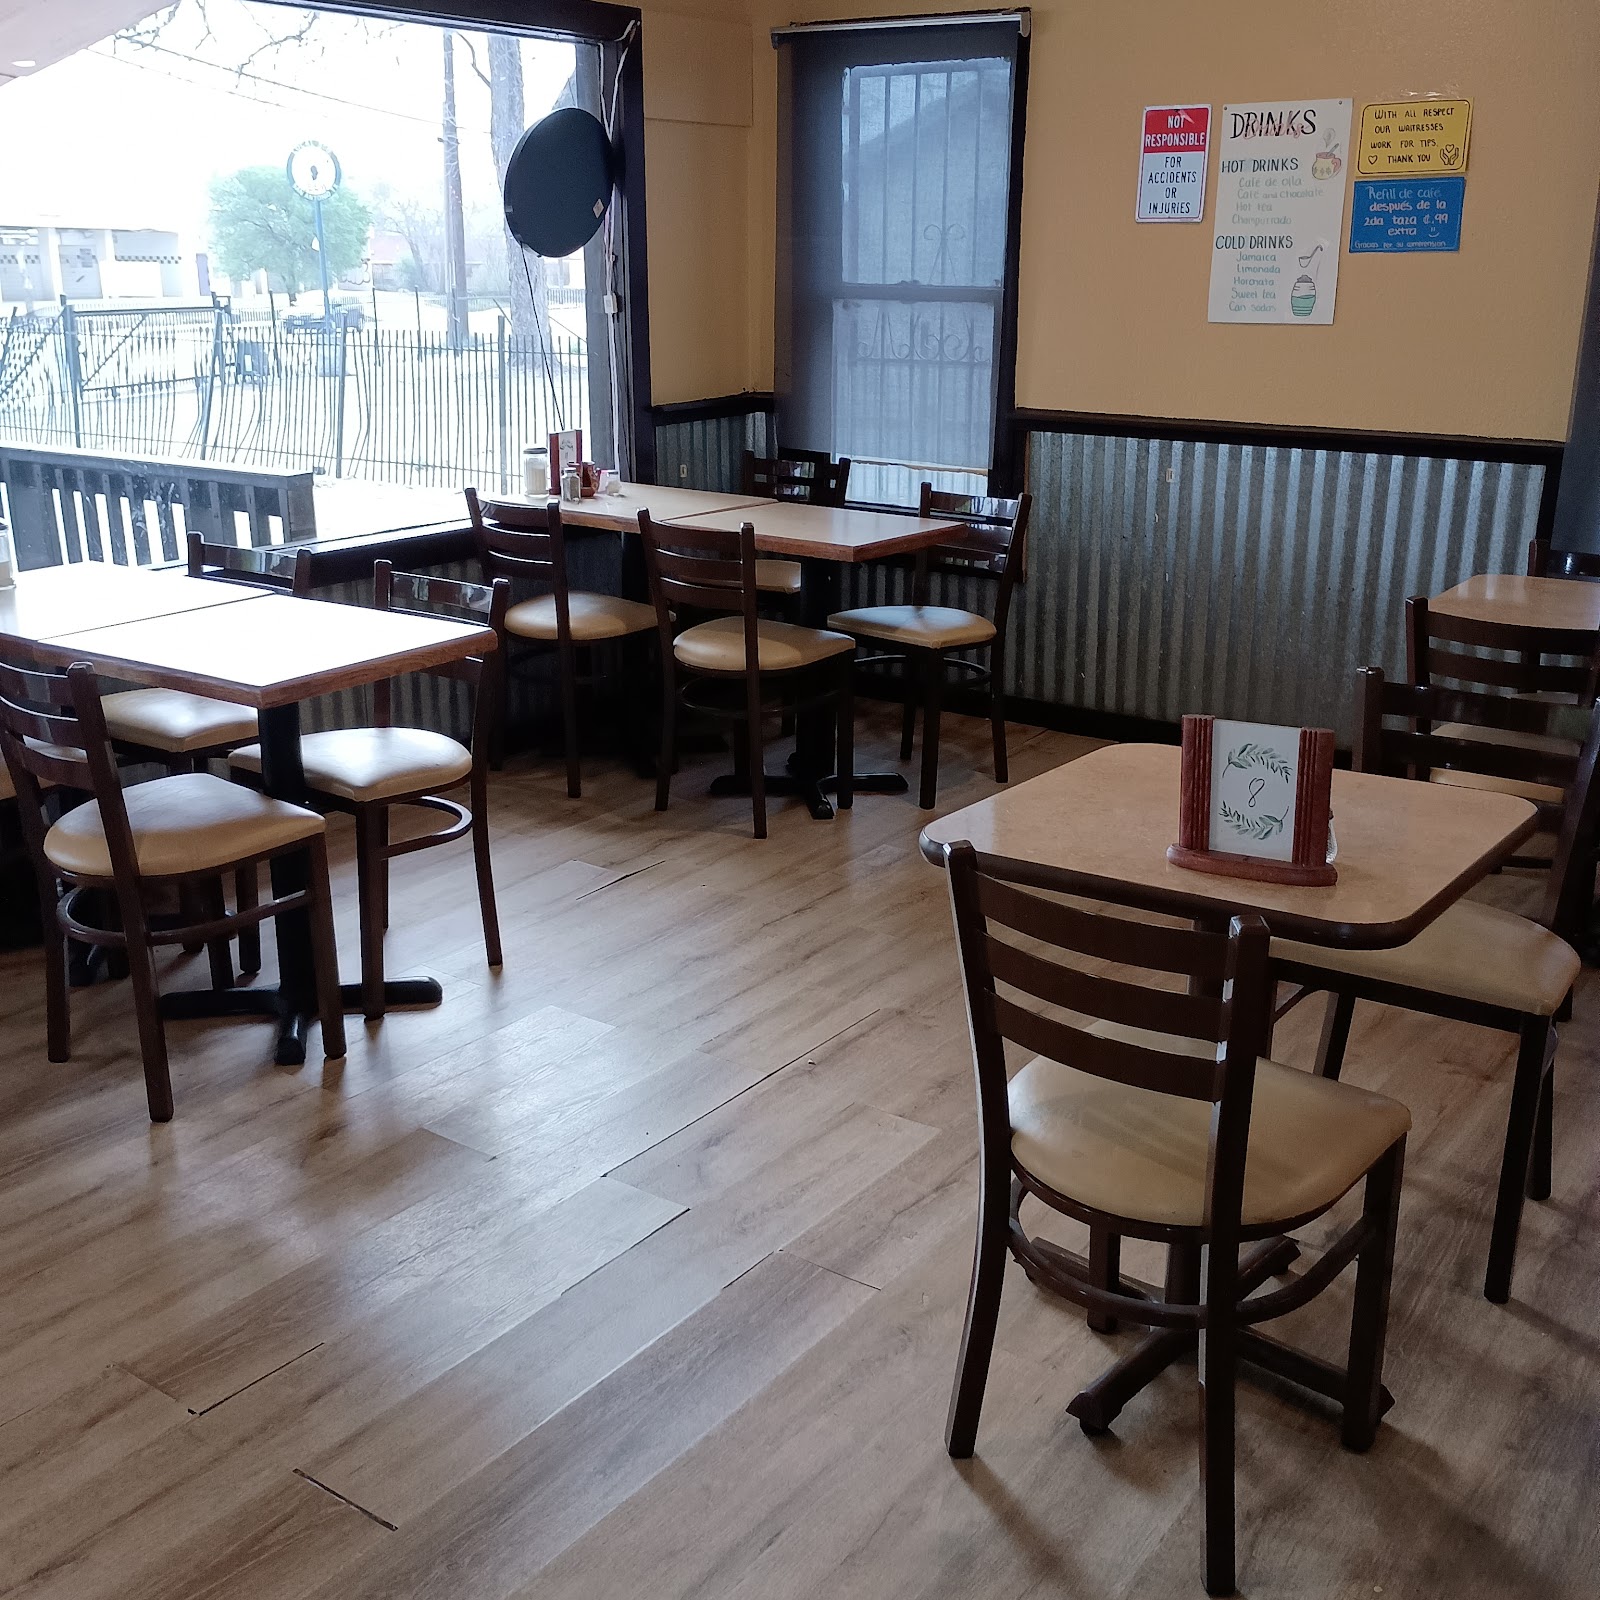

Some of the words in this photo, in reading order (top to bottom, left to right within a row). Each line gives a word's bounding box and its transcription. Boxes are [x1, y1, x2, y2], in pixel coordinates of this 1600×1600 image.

[1374, 109, 1397, 119] WITH
[1404, 109, 1416, 117] ALL
[1423, 107, 1455, 118] RESPECT
[1167, 115, 1186, 129] NOT
[1230, 109, 1316, 139] DRINKS
[1374, 125, 1391, 134] OUR
[1398, 123, 1444, 132] WAITRESSES
[1145, 132, 1205, 147] RESPONSIBLE
[1370, 141, 1391, 149] WORK
[1400, 140, 1414, 148] FOR
[1165, 156, 1182, 168] FOR
[1221, 160, 1244, 173] HOT
[1252, 157, 1299, 172] DRINKS
[1387, 154, 1413, 164] THANK
[1417, 154, 1431, 163] YOU
[1148, 171, 1197, 184] ACCIDENTS
[1264, 176, 1278, 187] de
[1281, 175, 1302, 188] olla
[1165, 187, 1177, 199] OR
[1365, 186, 1396, 200] Refill
[1398, 188, 1413, 199] de
[1148, 202, 1191, 214] INJURIES
[1236, 202, 1251, 211] Hot
[1257, 202, 1273, 211] tea
[1369, 200, 1413, 213] después
[1416, 200, 1430, 210] de
[1436, 199, 1447, 209] la
[1363, 216, 1384, 226] 2da
[1392, 215, 1417, 225] taza
[1387, 227, 1417, 236] extra
[1215, 235, 1245, 249] COLD
[1249, 235, 1293, 249] DRINKS
[1236, 251, 1277, 262] Jamaica
[1231, 287, 1258, 299] Sweet
[1262, 289, 1276, 299] tea
[1228, 301, 1247, 312] Can
[1251, 303, 1277, 312] sodas
[1248, 777, 1266, 808] 8
